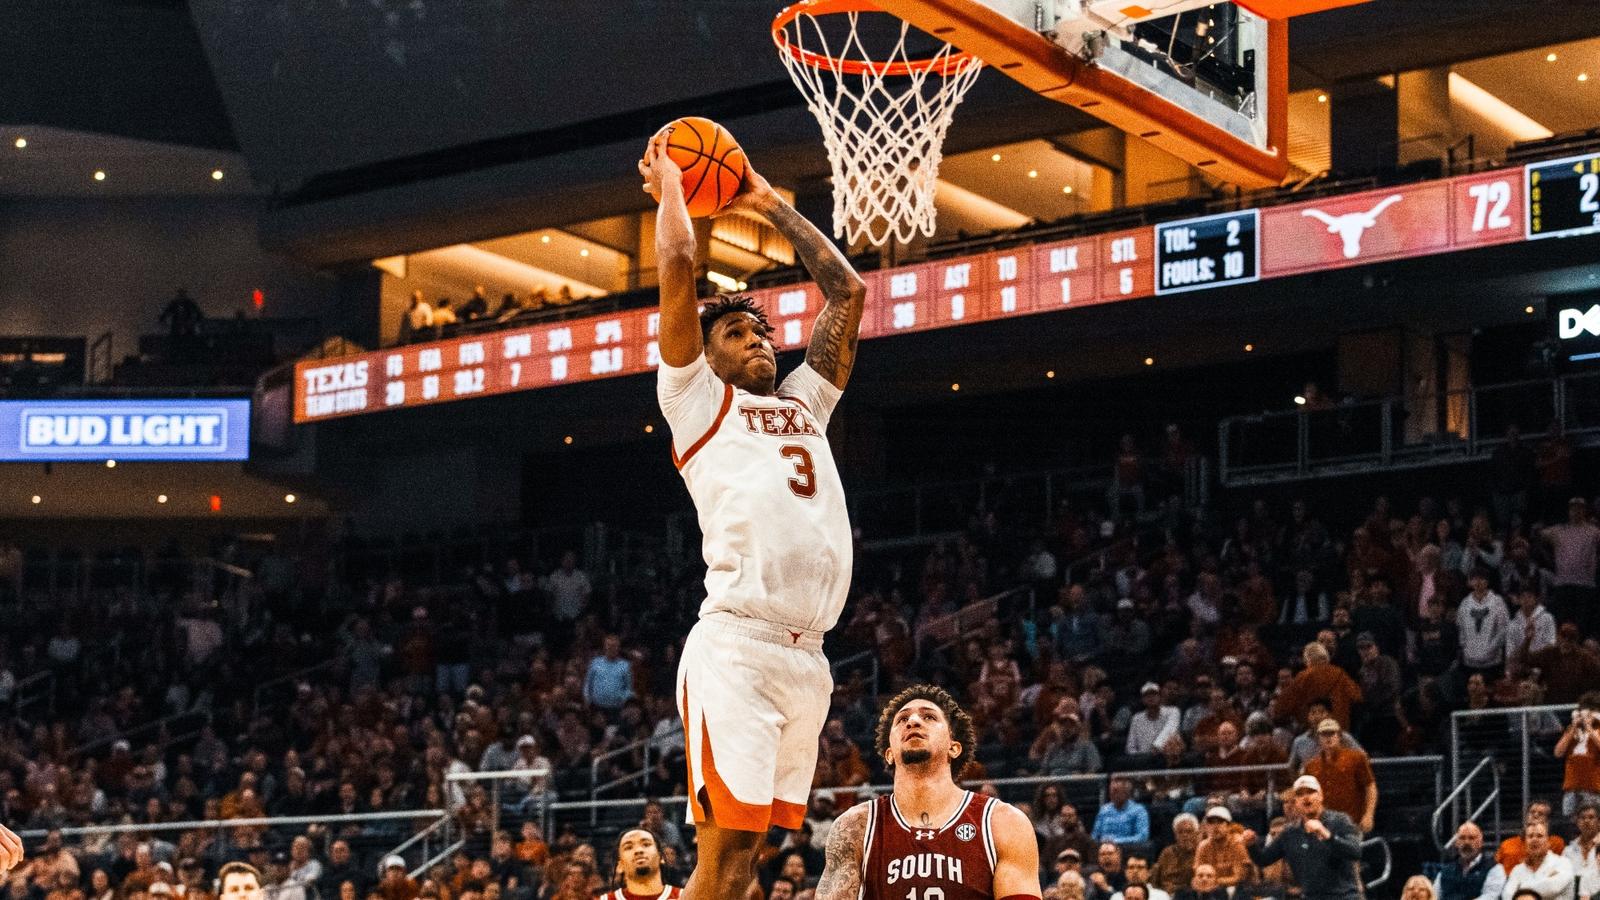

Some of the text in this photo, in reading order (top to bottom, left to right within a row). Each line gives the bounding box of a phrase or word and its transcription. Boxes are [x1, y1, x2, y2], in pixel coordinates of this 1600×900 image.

[1469, 181, 1511, 232] 72
[1163, 219, 1240, 253] TOL: 2
[1050, 247, 1077, 273] BLK
[1111, 238, 1136, 262] STL
[944, 264, 970, 289] AST
[1120, 268, 1132, 294] 5
[1163, 251, 1244, 287] FOULS: 10
[1001, 287, 1016, 312] 11
[1061, 278, 1070, 303] 1
[304, 360, 368, 396] TEXAS
[511, 363, 521, 386] 7
[27, 416, 220, 445] BUD LIGHT
[779, 444, 817, 499] 3
[956, 824, 975, 840] SEC
[887, 853, 963, 884] SOUTH
